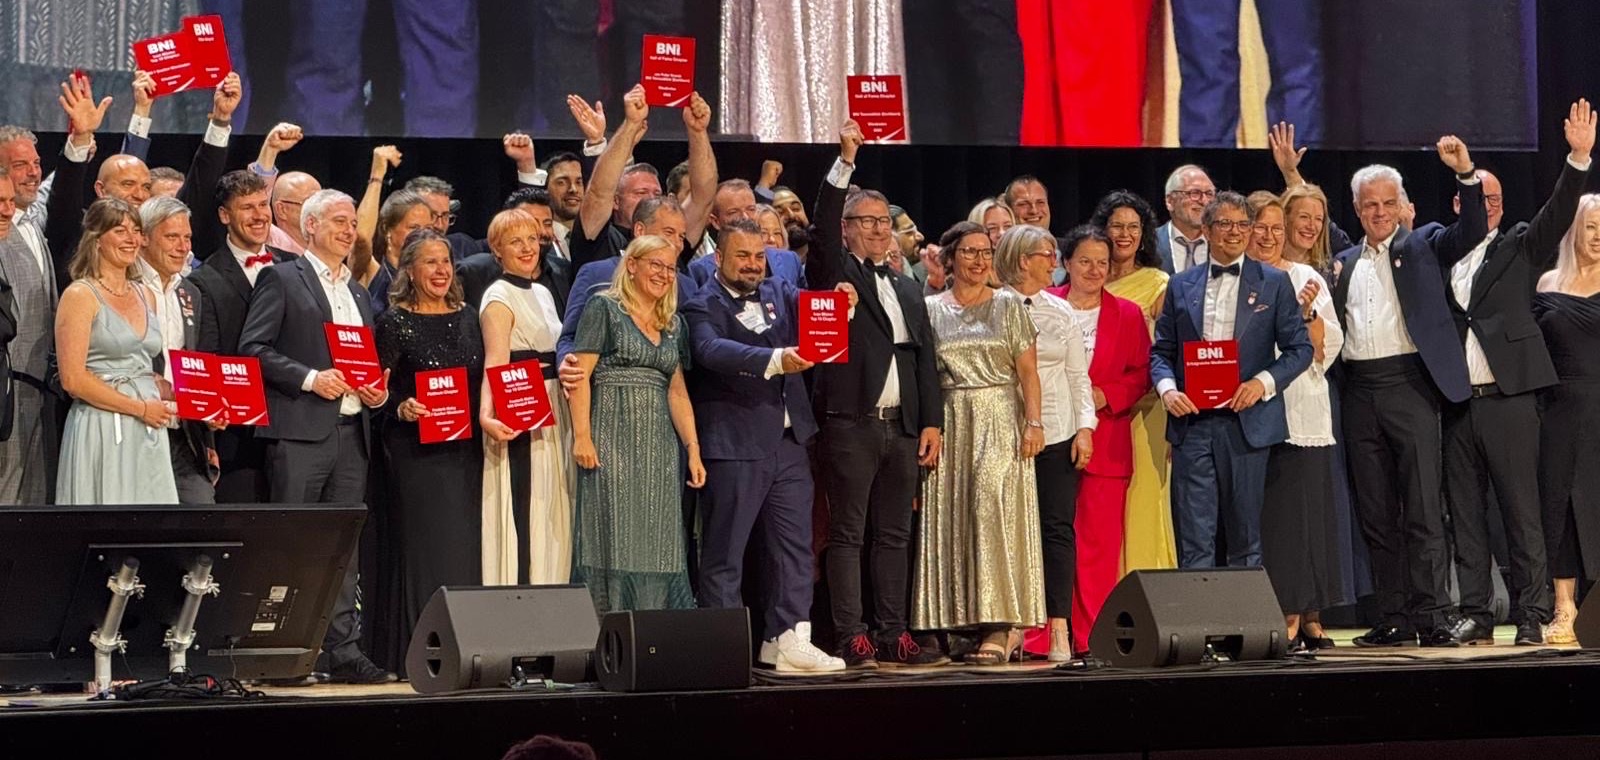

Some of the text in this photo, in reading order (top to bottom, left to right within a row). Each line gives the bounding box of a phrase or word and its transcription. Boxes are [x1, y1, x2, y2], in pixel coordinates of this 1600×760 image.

[193, 23, 214, 36] BNI
[147, 39, 176, 55] BNI
[656, 42, 681, 55] BNI
[861, 81, 888, 92] BNI
[811, 298, 835, 310] BNI
[337, 330, 362, 342] BNI
[1197, 347, 1223, 359] BNI
[181, 357, 205, 371] BNI
[221, 363, 248, 375] BNI
[501, 367, 528, 383] BNI
[429, 375, 454, 390] BNI
